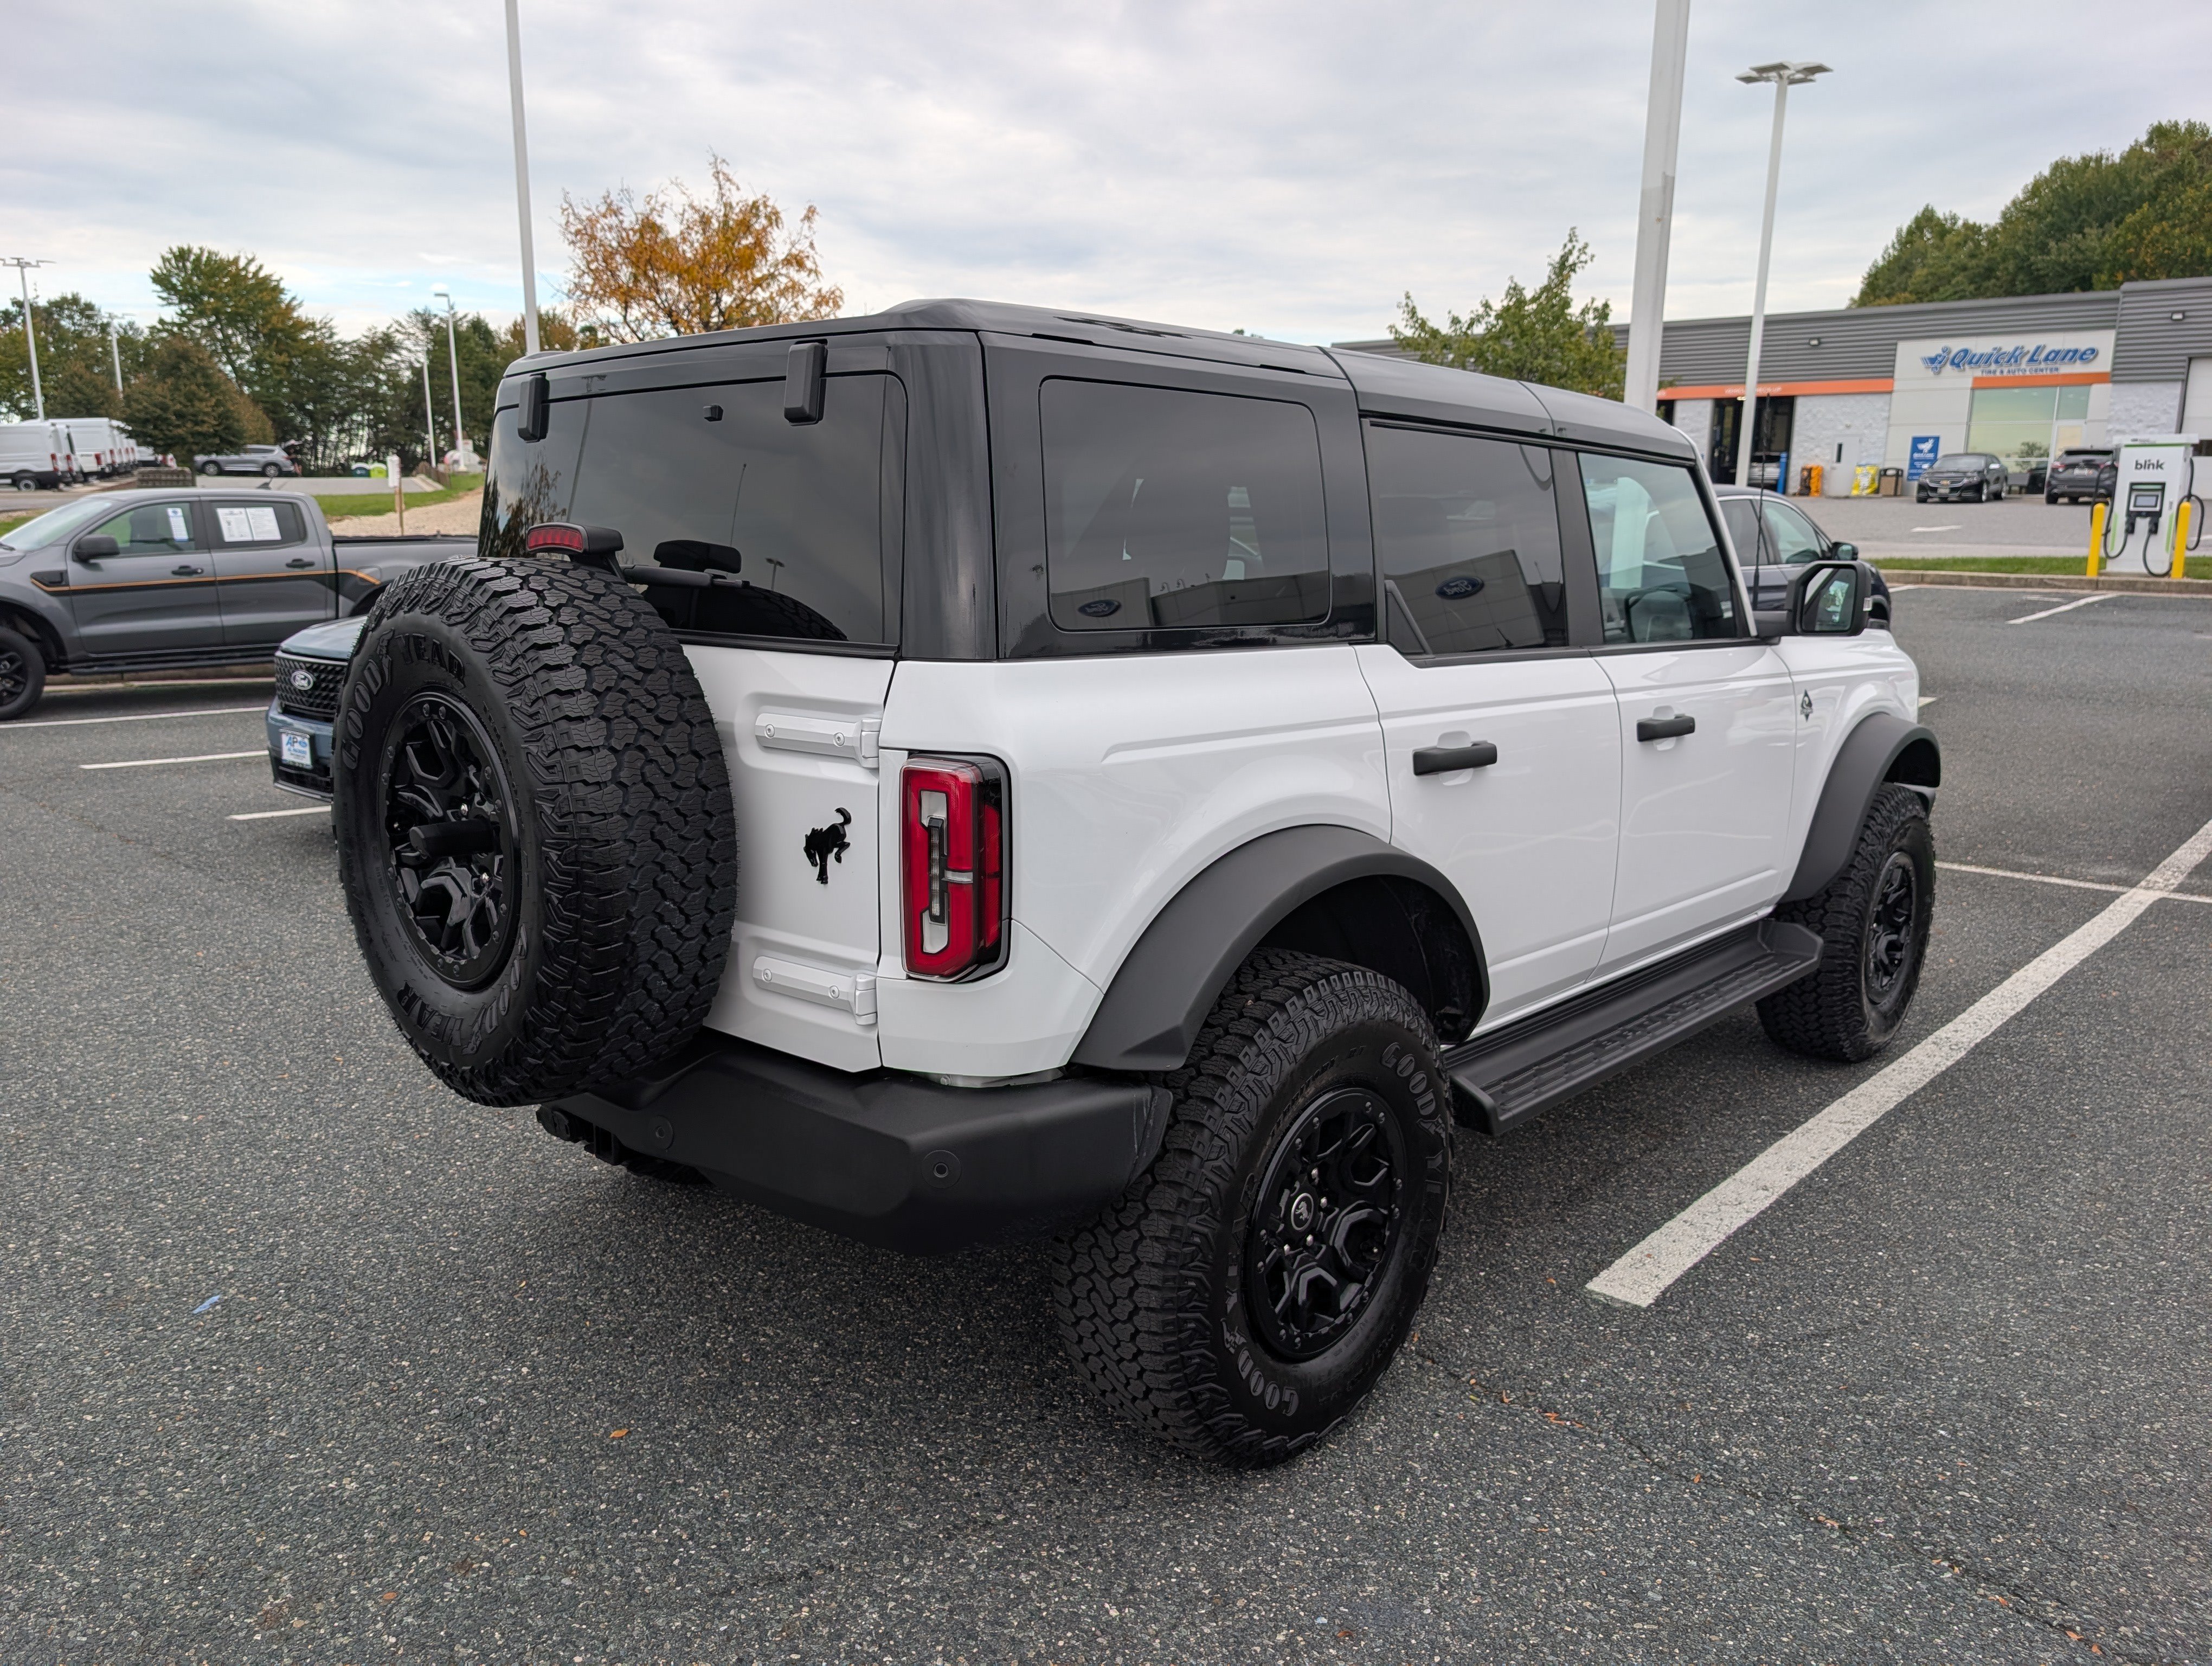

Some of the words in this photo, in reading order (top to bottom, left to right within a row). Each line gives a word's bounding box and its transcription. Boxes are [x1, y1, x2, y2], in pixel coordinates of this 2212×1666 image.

[1949, 345, 2029, 371] Quick
[2025, 343, 2099, 366] Lane
[2029, 366, 2059, 374] CENTER
[2134, 459, 2164, 470] blink
